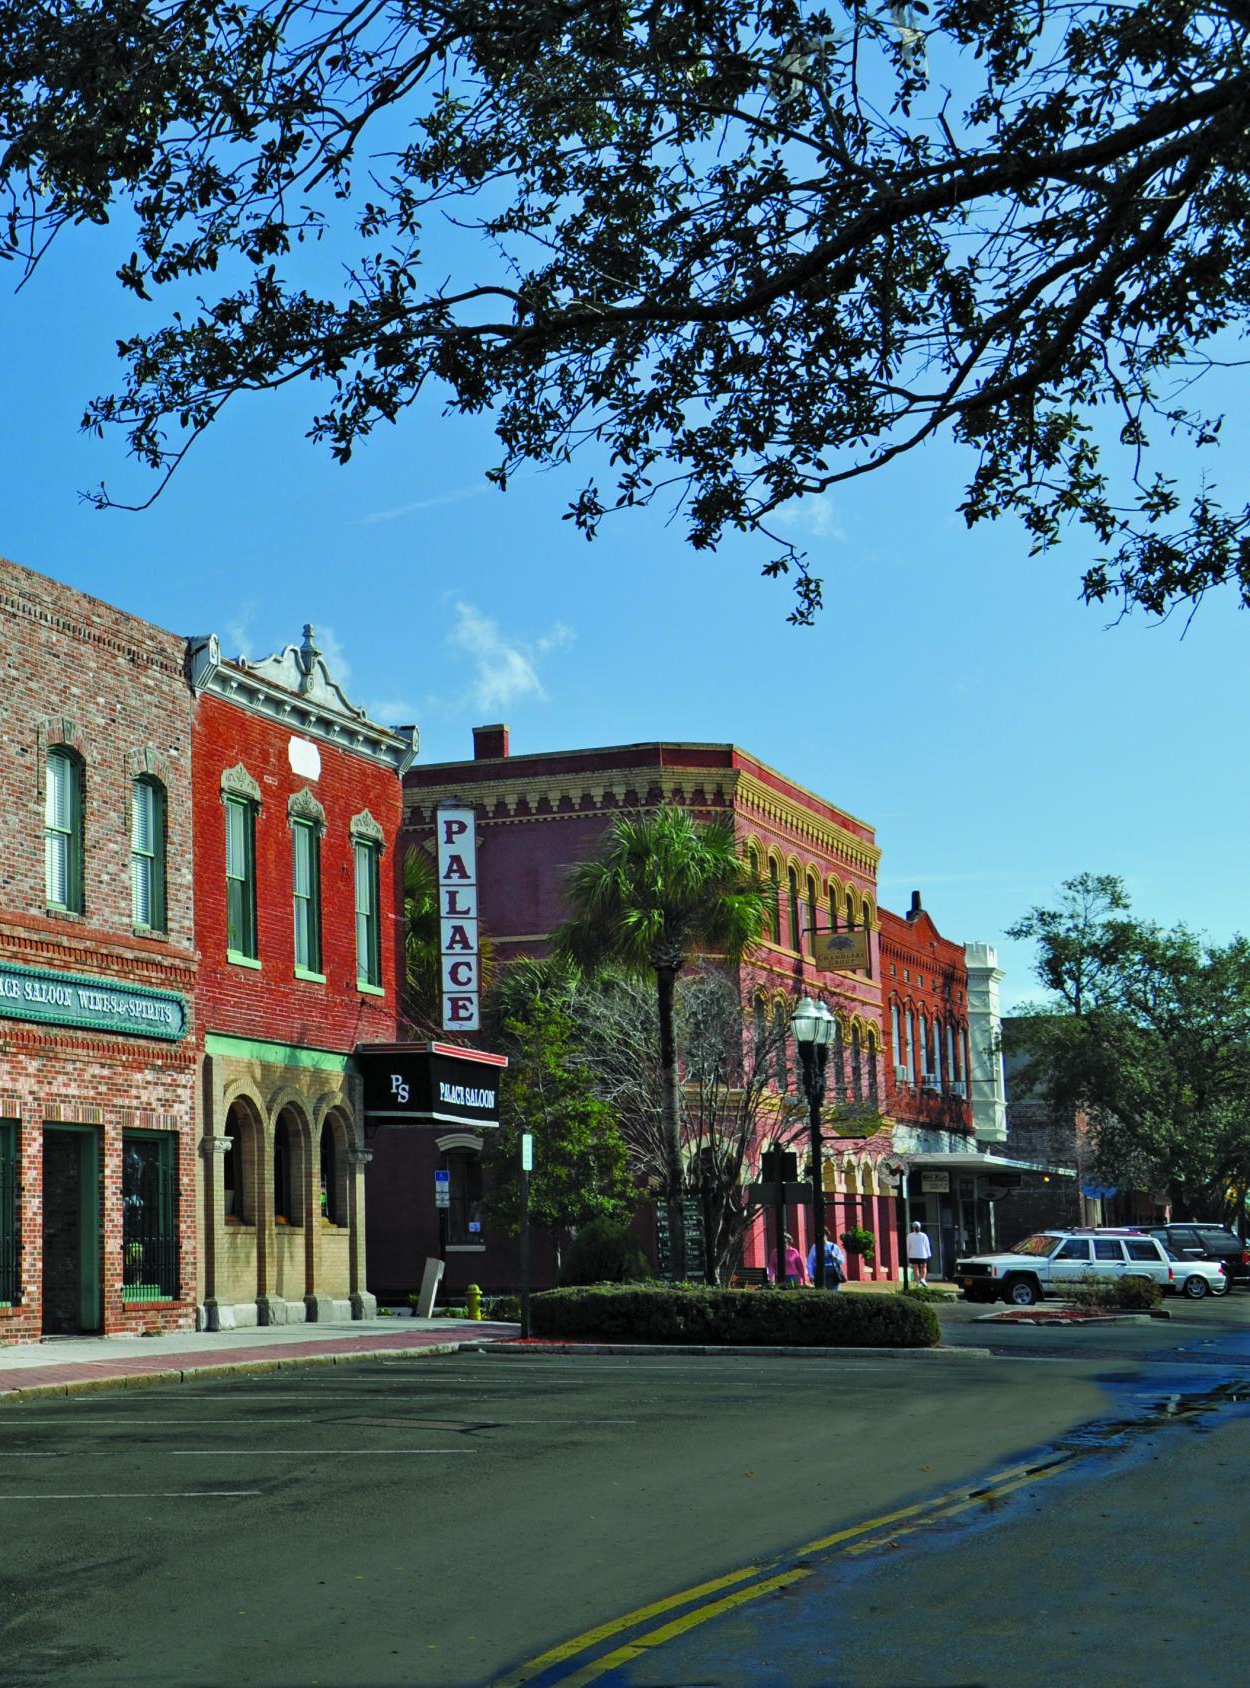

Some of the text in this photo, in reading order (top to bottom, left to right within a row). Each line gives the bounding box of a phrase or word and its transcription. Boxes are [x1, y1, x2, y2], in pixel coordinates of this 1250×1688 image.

[443, 819, 474, 1022] PALACE
[23, 981, 73, 1006] SALOON
[439, 1081, 496, 1109] PALACE SALOON
